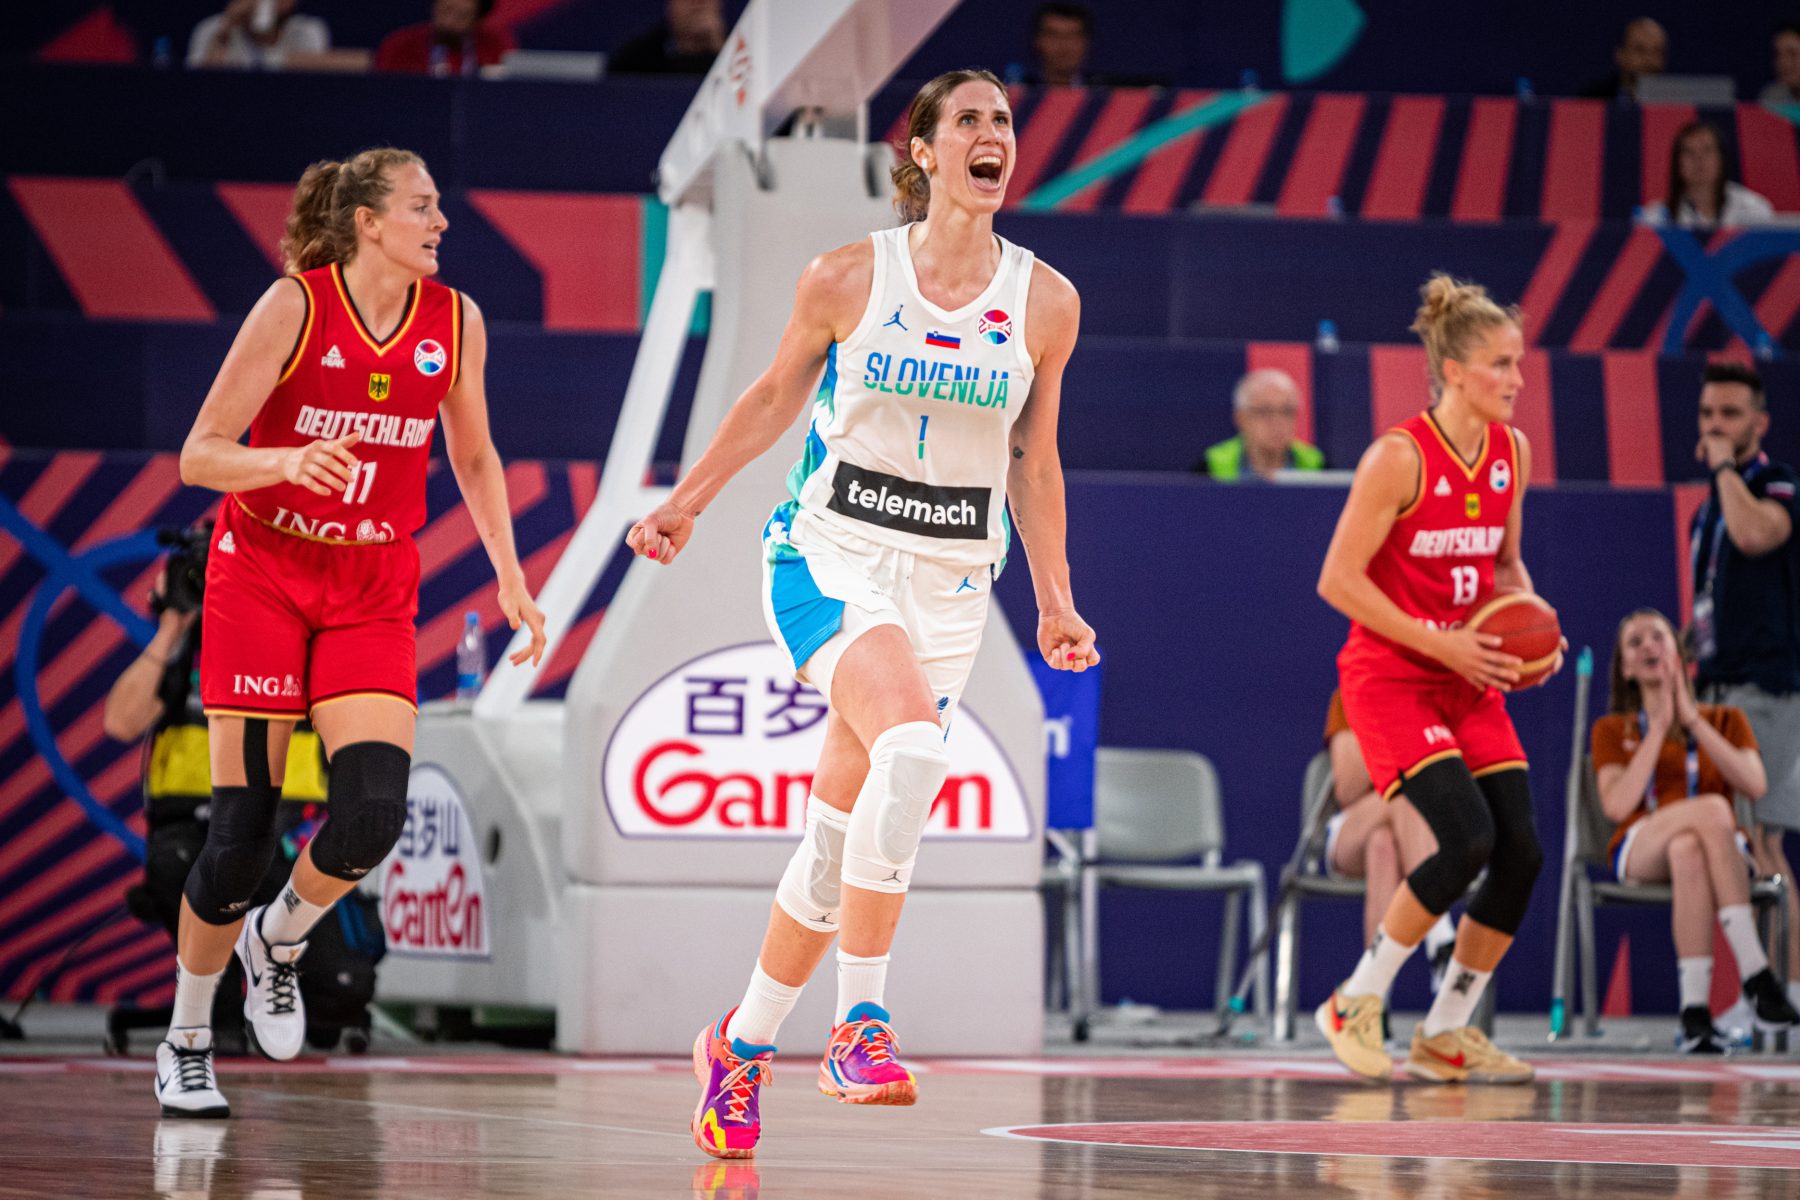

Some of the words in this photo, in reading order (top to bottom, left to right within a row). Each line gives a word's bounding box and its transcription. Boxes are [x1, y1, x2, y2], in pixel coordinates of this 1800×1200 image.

[863, 351, 1009, 409] SLOVENIJA
[918, 415, 929, 460] 1
[273, 506, 346, 542] ING
[847, 479, 977, 526] telemach
[1450, 565, 1479, 606] 13
[233, 674, 279, 697] ING
[685, 676, 829, 738] 百岁
